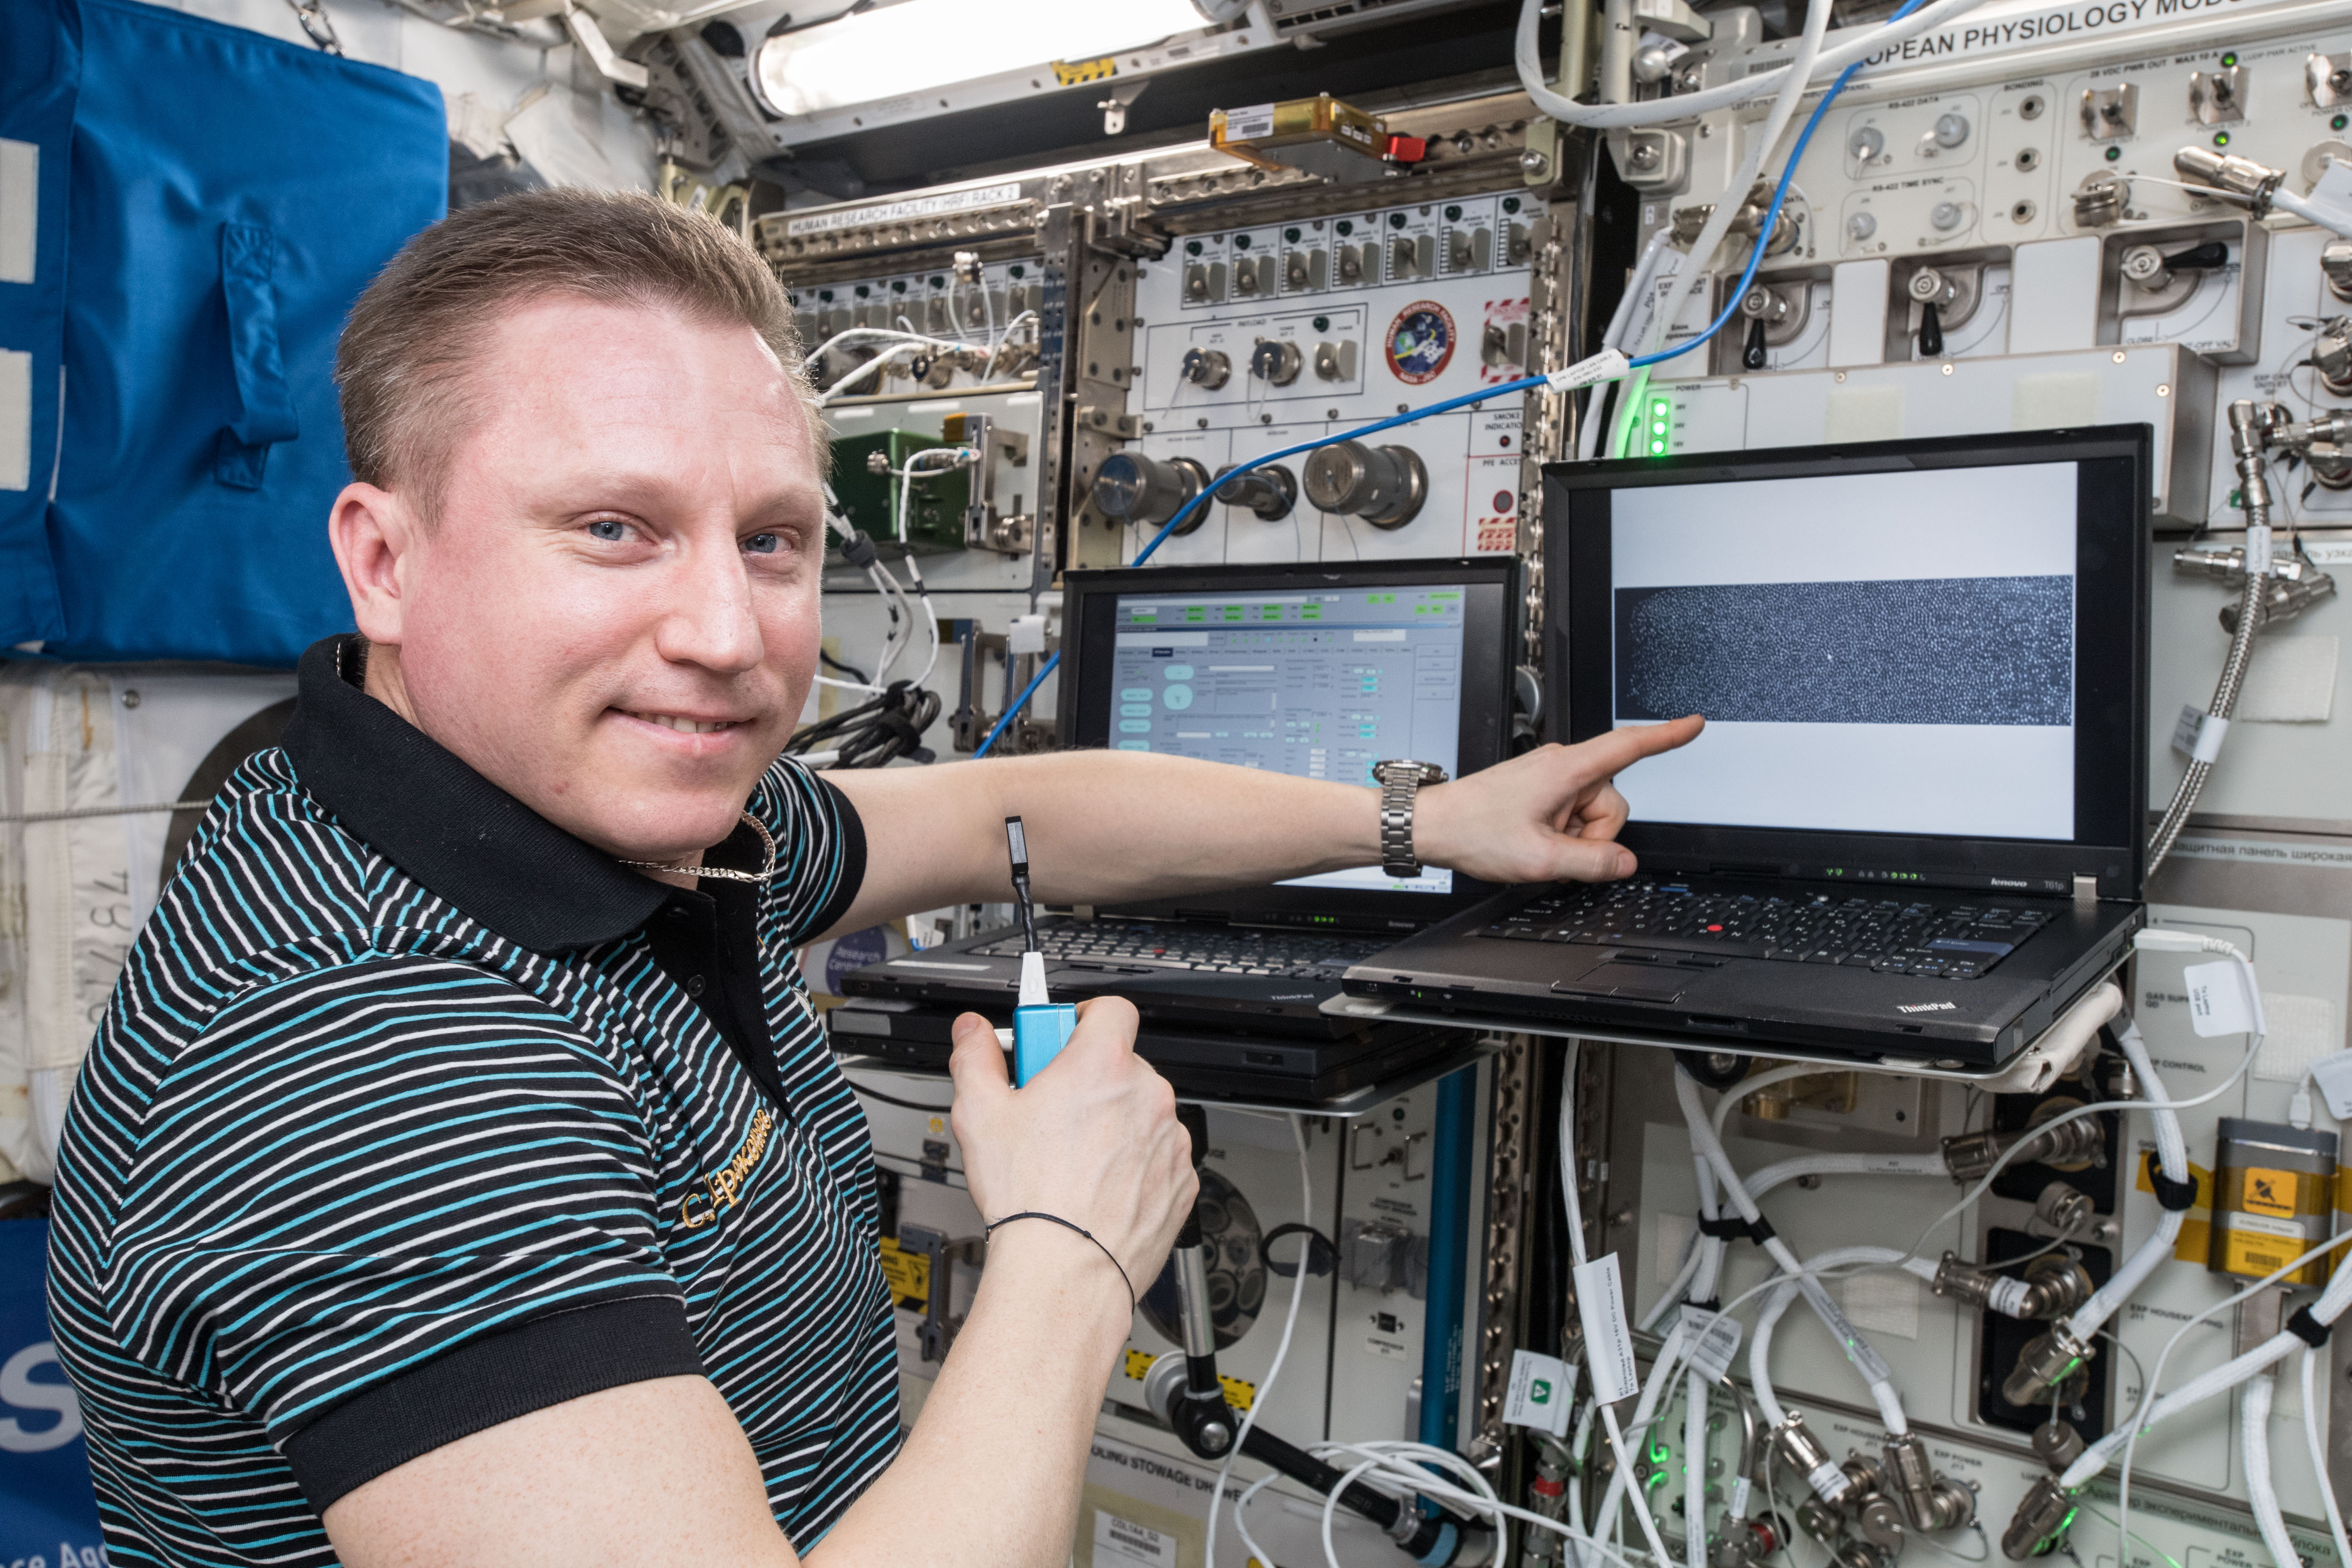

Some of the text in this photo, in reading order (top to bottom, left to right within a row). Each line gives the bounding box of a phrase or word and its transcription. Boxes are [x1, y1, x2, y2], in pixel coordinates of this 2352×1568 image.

[1964, 0, 2147, 49] PHYSIOLOGY
[2287, 43, 2317, 54] ACTIVE
[2175, 55, 2196, 64] MAX
[890, 198, 936, 218] FACILITY
[1007, 187, 1014, 199] 2
[1675, 384, 1701, 392] POWER
[1493, 412, 1520, 421] SMOKE
[1485, 420, 1522, 430] INDICATIO
[1991, 878, 2028, 887] lenovo
[834, 945, 881, 963] Research
[1897, 1001, 1956, 1013] ThinkPad
[1611, 1312, 1617, 1322] DC
[1933, 1449, 1982, 1467] EXP POWER
[1130, 1456, 1193, 1487] STOWAGE
